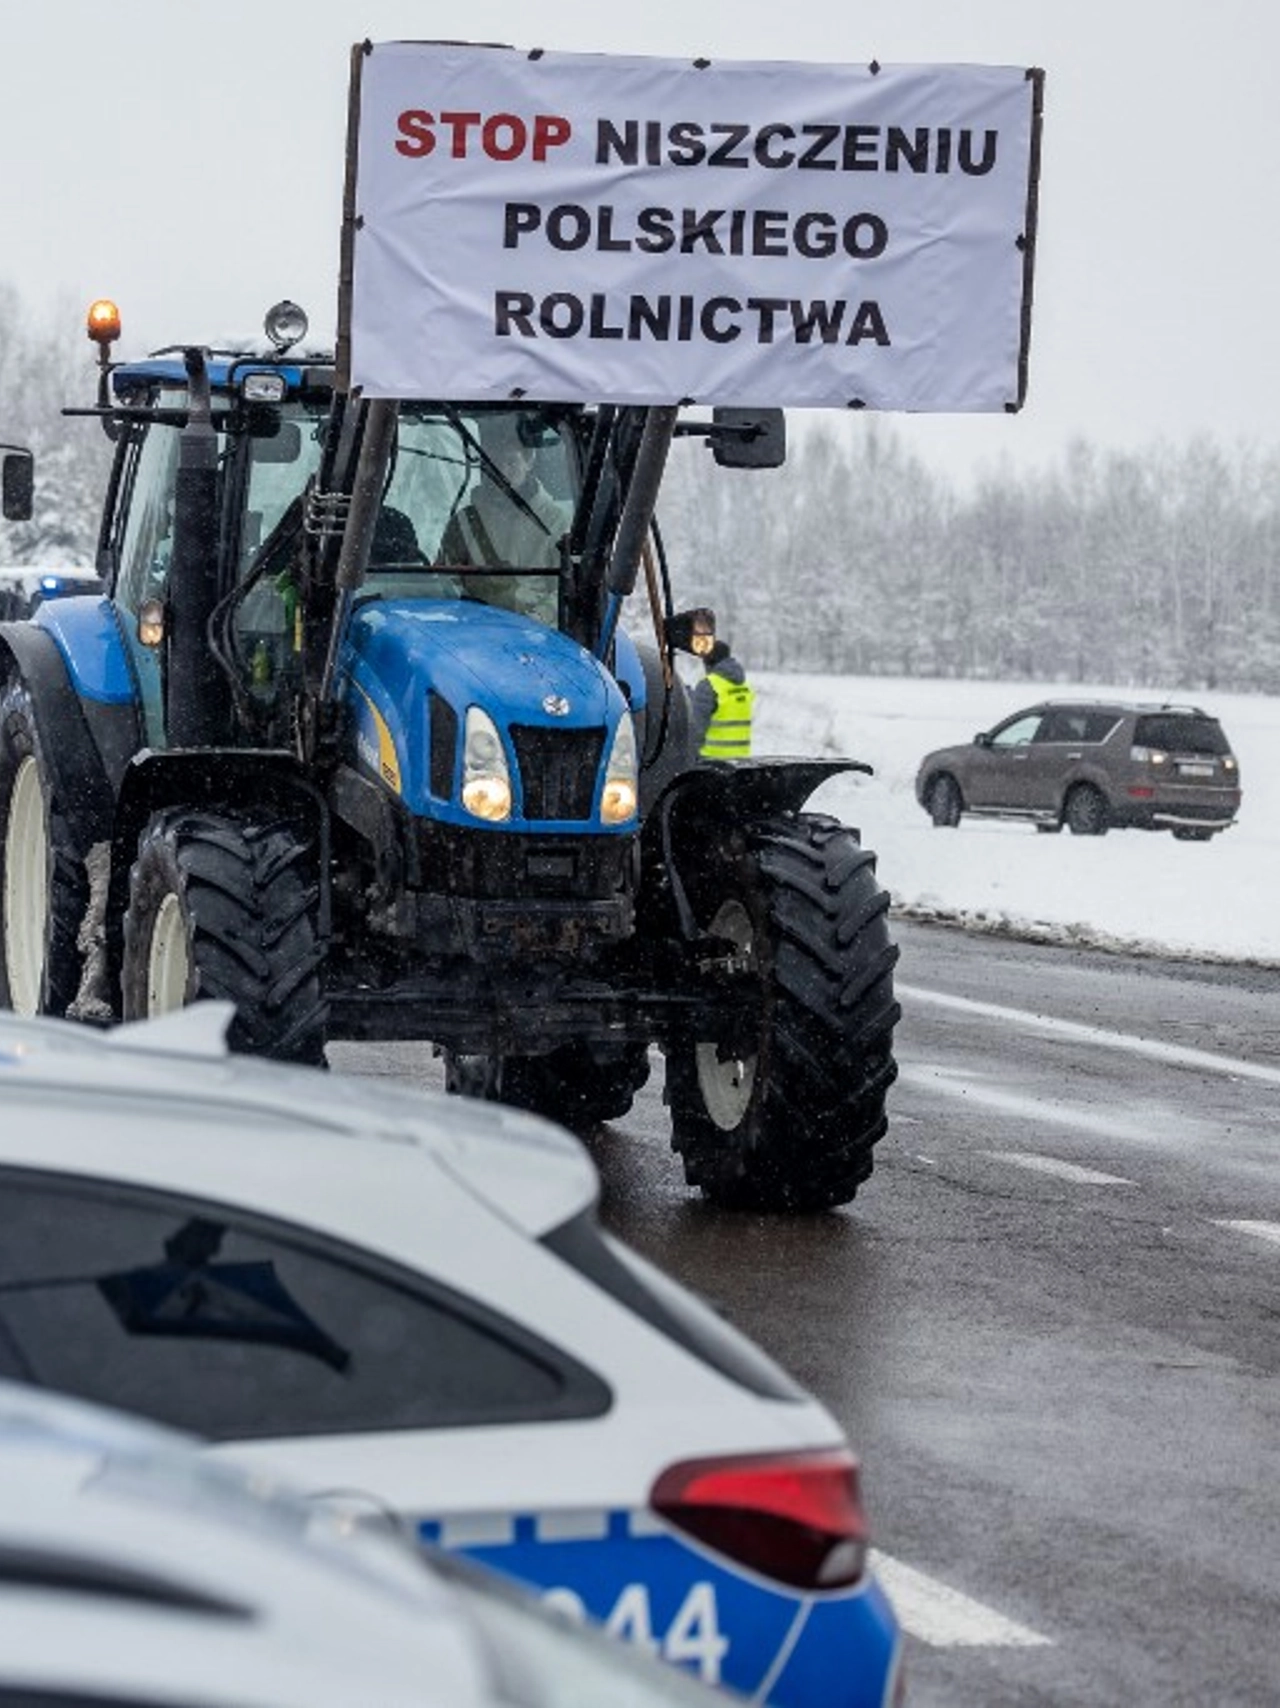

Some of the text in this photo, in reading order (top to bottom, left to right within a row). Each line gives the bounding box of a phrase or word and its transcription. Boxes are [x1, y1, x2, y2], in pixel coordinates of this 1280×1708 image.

[395, 110, 999, 176] STOP NISZCZENIU
[503, 203, 889, 259] POLSKIEGO
[495, 291, 891, 347] ROLNICTWA
